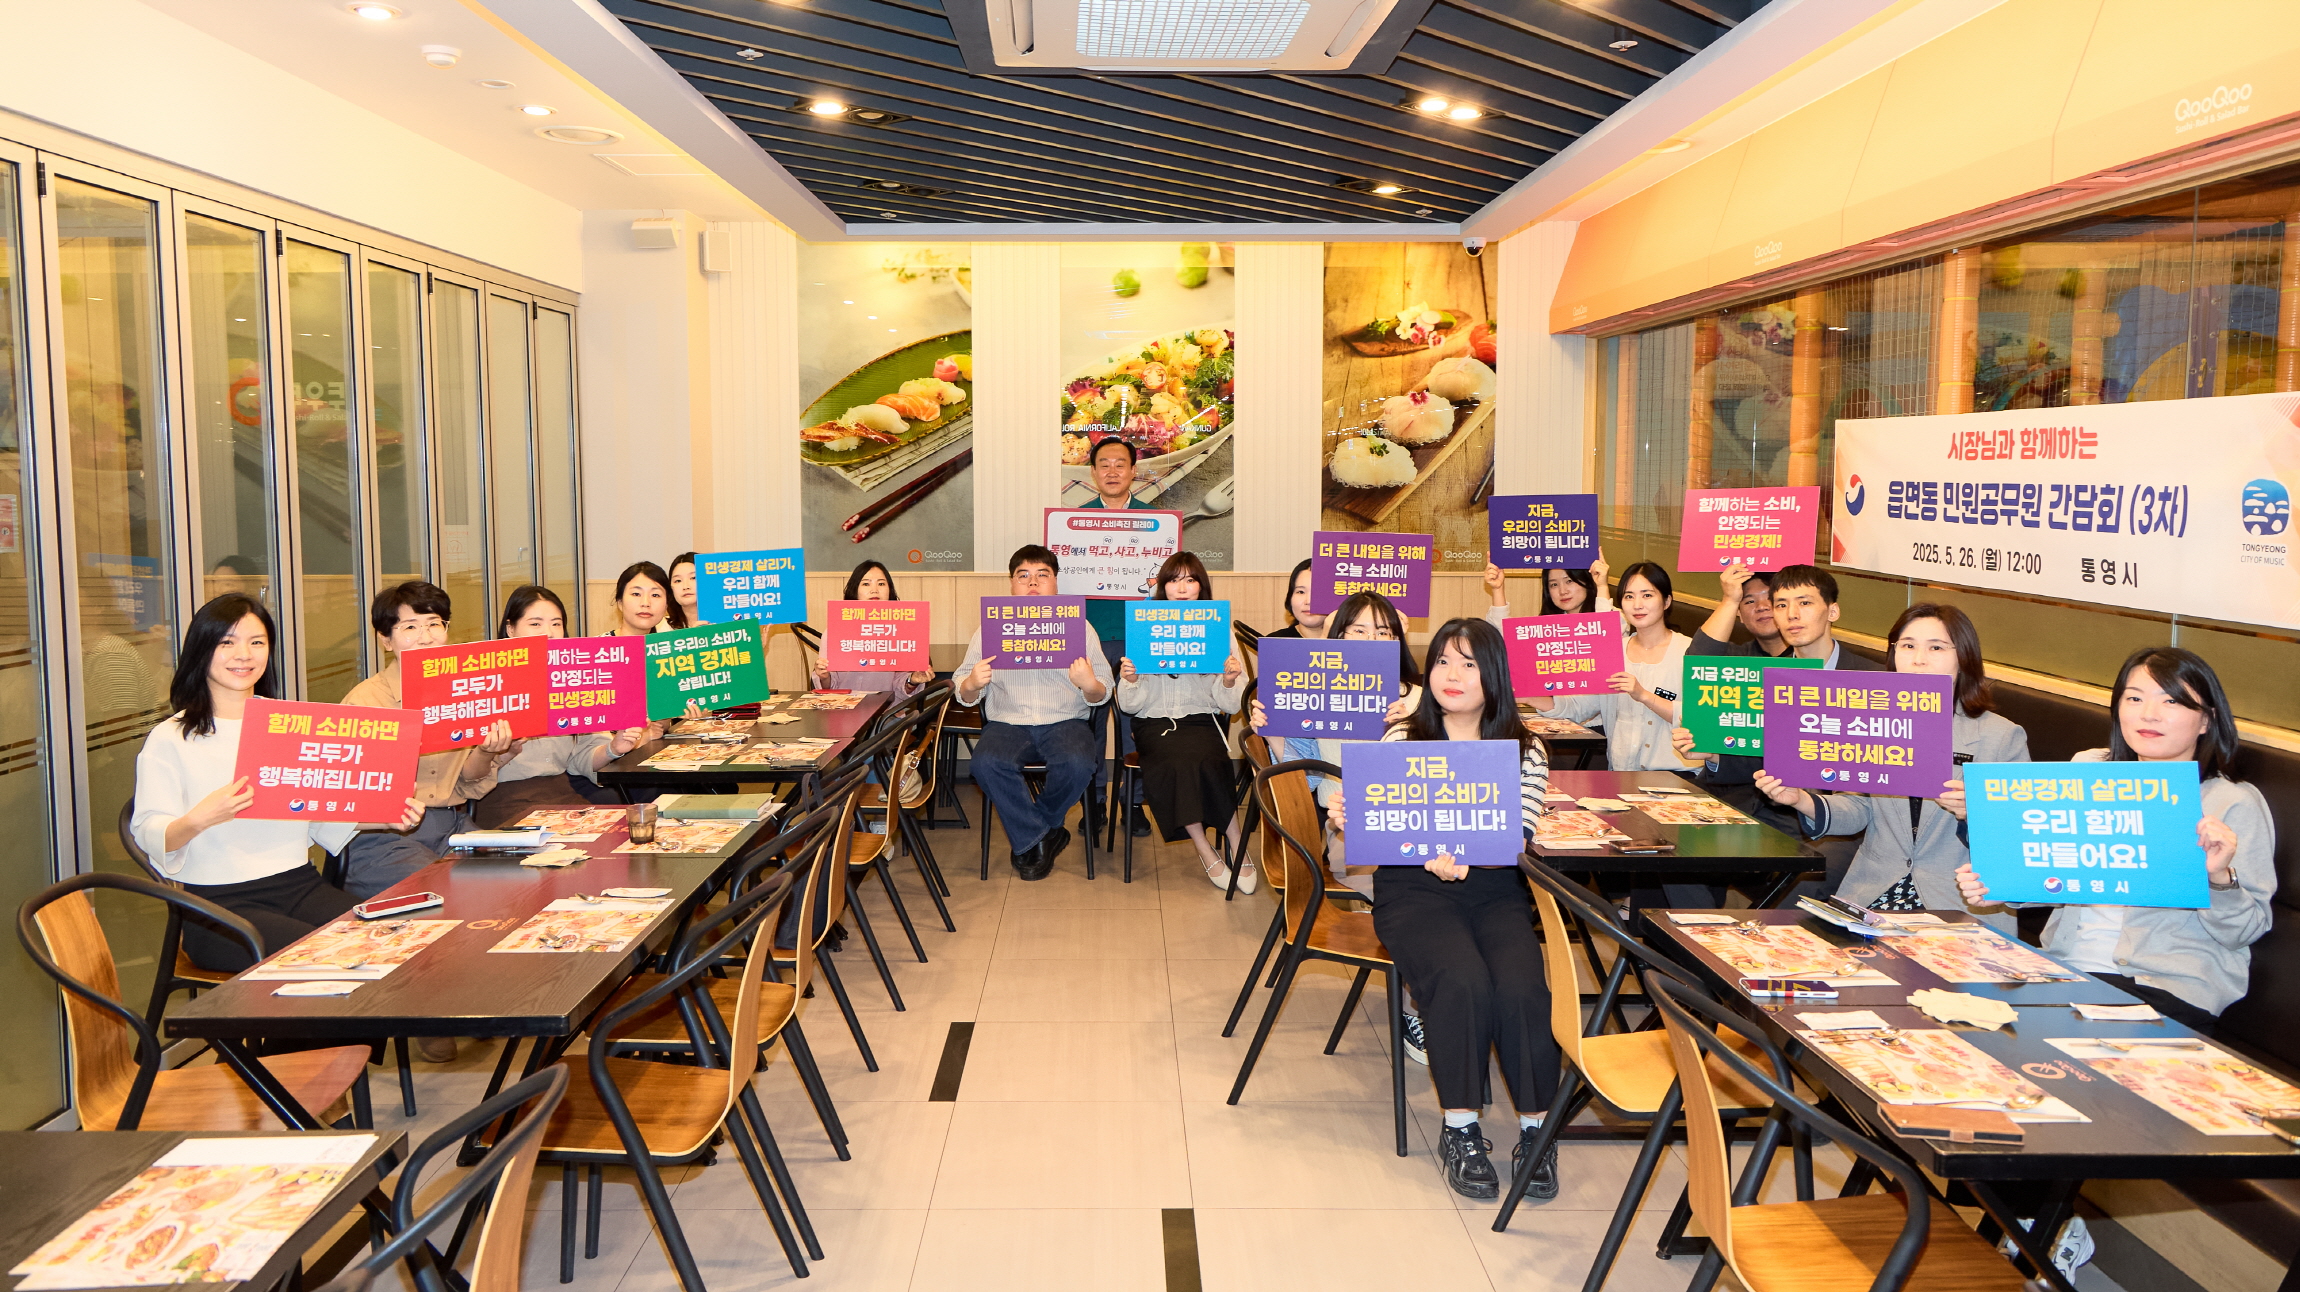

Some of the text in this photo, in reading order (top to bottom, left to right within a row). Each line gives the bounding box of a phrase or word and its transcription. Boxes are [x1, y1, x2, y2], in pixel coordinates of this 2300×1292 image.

[2175, 84, 2252, 122] QooQoo
[2217, 107, 2236, 121] Salad
[2238, 105, 2250, 115] Bar
[1947, 426, 2099, 461] 시장님과 함께하는
[1528, 504, 1559, 519] 지금,
[1699, 496, 1801, 513] 함께하는 소비,
[1888, 480, 2189, 538] 읍면동 민원공무원 간담회 (3차)
[1503, 520, 1586, 534] 우리의 소비가
[1718, 516, 1781, 531] 안정되는
[1502, 536, 1590, 549] 희망이 됩니다!
[1714, 534, 1782, 549] 민생경제!
[2242, 544, 2286, 554] TONGYEONG
[925, 551, 962, 559] QooQoo
[1050, 545, 1087, 557] 통영에서
[1089, 545, 1113, 558] 먹고,
[1115, 546, 1139, 558] 사고,
[1188, 550, 1223, 558] ooQoo
[1320, 543, 1426, 560] 더 큰 내일을 위해
[1444, 551, 1482, 559] QooQoo
[1912, 542, 1942, 565] 2025.
[1945, 547, 1955, 566] 5.
[1960, 547, 1977, 569] 26.
[1981, 548, 2002, 572] (월)
[2007, 552, 2042, 575] 12:00
[705, 558, 795, 575] 민생경제 살리기,
[2241, 555, 2285, 566] CITY OF MUSIC
[1097, 567, 1105, 575] 큰
[1335, 562, 1408, 579] 오늘 소비에
[723, 575, 780, 591] 우리 함께
[723, 593, 781, 609] 만들어요!
[842, 608, 916, 621] 함께 소비하면
[987, 605, 1080, 620] 더 큰 내일을 위해
[1135, 609, 1221, 622] 민생경제 살리기,
[861, 624, 897, 636] 모두가
[1002, 622, 1065, 636] 오늘 소비에
[1151, 625, 1206, 639] 우리 함께
[1516, 621, 1607, 640] 함께하는 소비,
[646, 629, 752, 656] 지금 우리의 소비가,
[840, 640, 916, 652] 행복해집니다!
[1002, 639, 1066, 652] 동참하세요!
[1150, 642, 1206, 656] 만들어요!
[1536, 641, 1592, 657] 안정되는
[422, 648, 529, 678] 함께 소비하면
[548, 646, 630, 666] 께하는 소비,
[656, 647, 751, 678] 지역 경제를
[1309, 652, 1349, 672] 지금,
[1536, 659, 1596, 675] 민생경제!
[1691, 667, 1760, 682] 지금 우리의
[452, 674, 504, 697] 모두가
[551, 669, 613, 688] 안정되는
[678, 672, 732, 692] 살립니다!
[1276, 672, 1383, 692] 우리의 소비가
[549, 690, 616, 710] 민생경제!
[1274, 693, 1388, 714] 희망이 됩니다!
[1698, 685, 1741, 710] 지역
[1747, 687, 1764, 710] 경
[1774, 686, 1942, 713] 더 큰 내일을 위해
[422, 694, 530, 725] 행복해집니다!
[268, 713, 400, 741] 함께 소비하면
[1719, 712, 1764, 728] 살립니
[1799, 713, 1913, 740] 오늘 소비에
[465, 726, 489, 739] 통영
[1738, 738, 1761, 749] 통영
[298, 742, 364, 764] 모두가
[1798, 740, 1914, 767] 동참하세요!
[1406, 757, 1456, 781] 지금,
[259, 766, 393, 792] 행복해집니다!
[1365, 783, 1500, 806] 우리의 소비가
[1985, 779, 2179, 805] 민생경제 살리기,
[1364, 810, 1507, 832] 희망이 됩니다!
[2022, 809, 2144, 836] 우리 함께
[2022, 842, 2148, 869] 만들어요!
